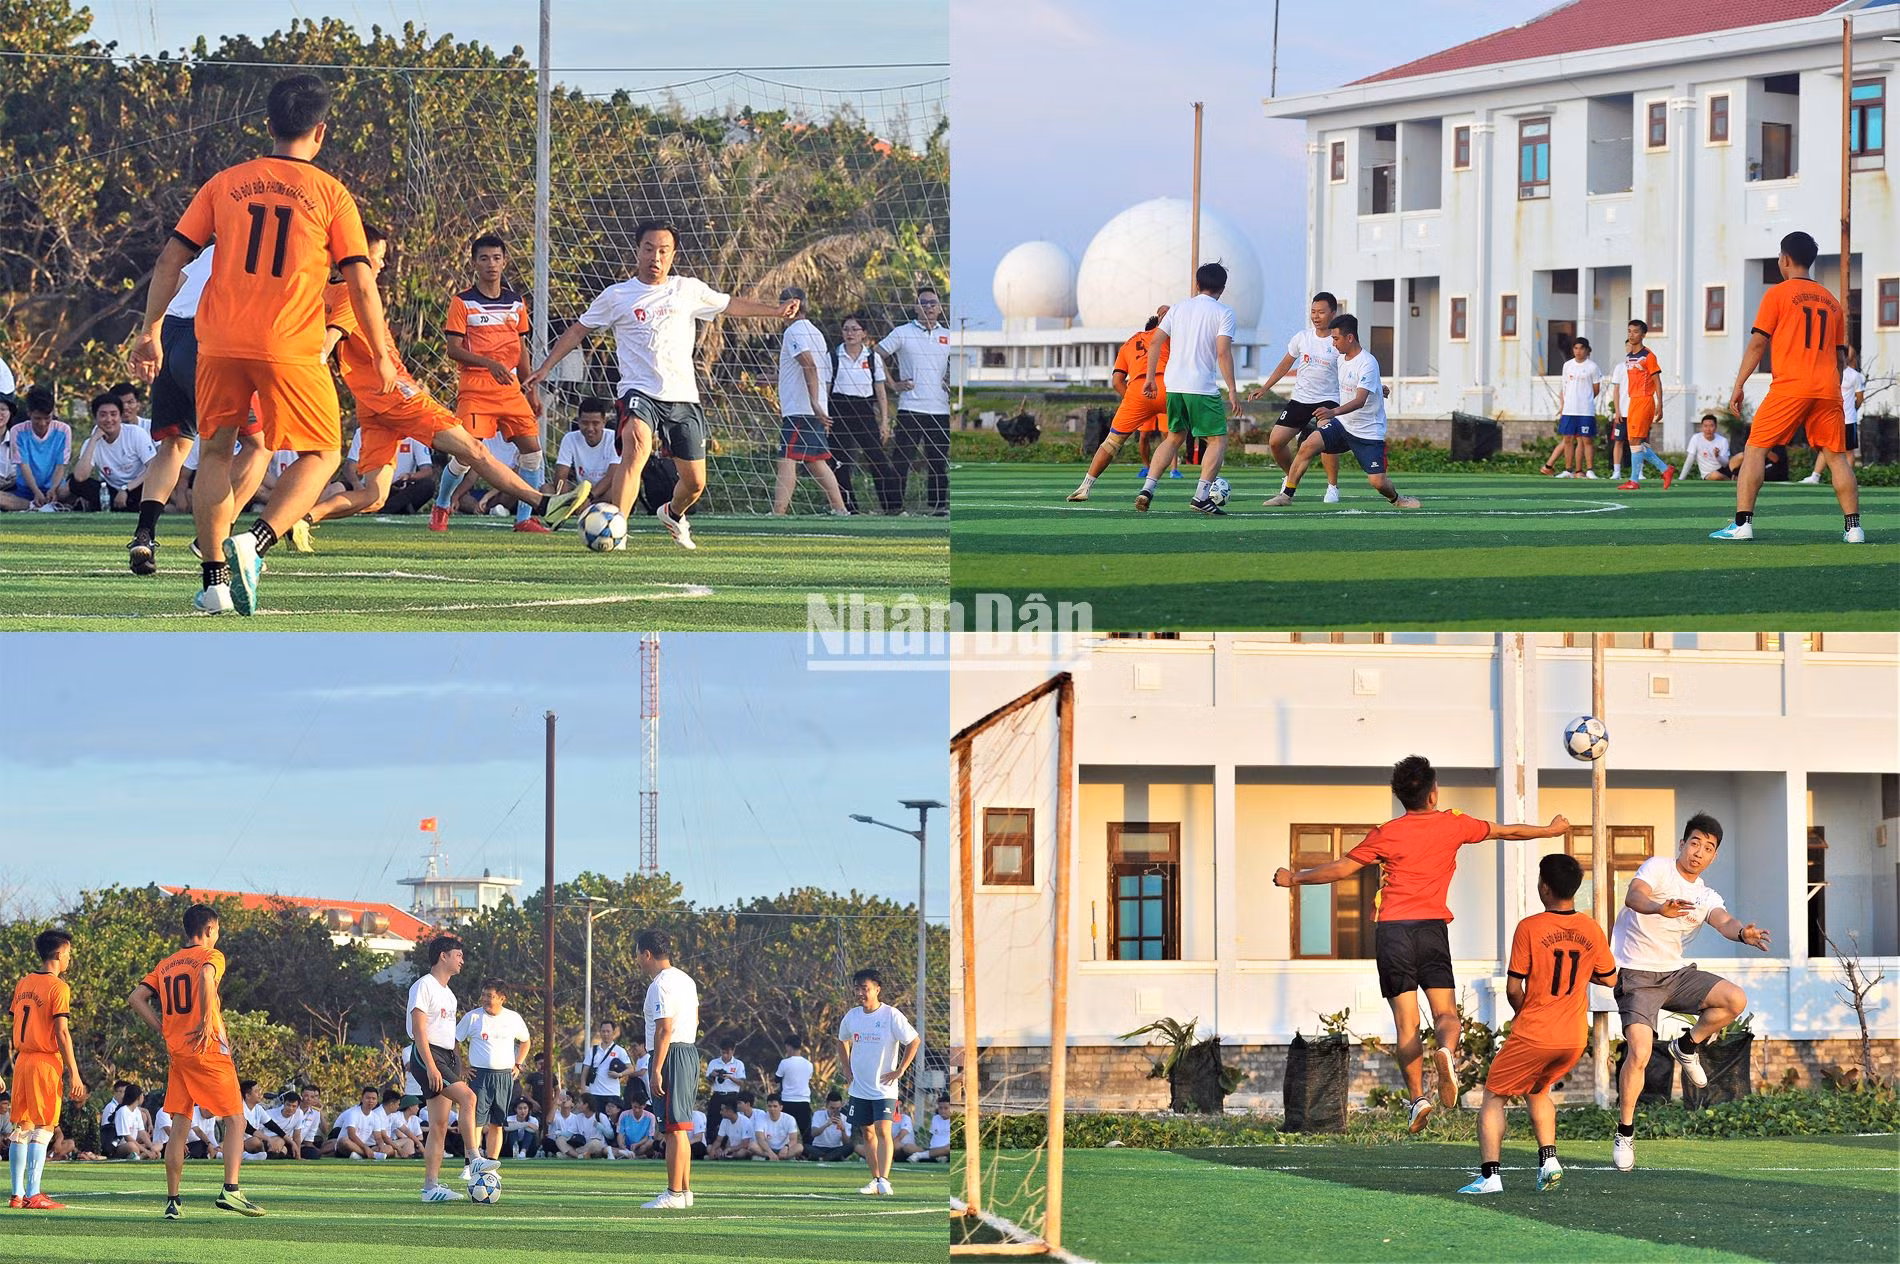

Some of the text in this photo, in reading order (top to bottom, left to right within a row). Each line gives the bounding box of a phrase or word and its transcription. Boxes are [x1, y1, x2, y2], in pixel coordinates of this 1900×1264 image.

[245, 202, 293, 278] 11
[1803, 306, 1828, 350] 11
[629, 396, 640, 409] 6
[1280, 410, 1287, 420] 8
[164, 973, 193, 1015] 10
[1551, 949, 1580, 996] 11
